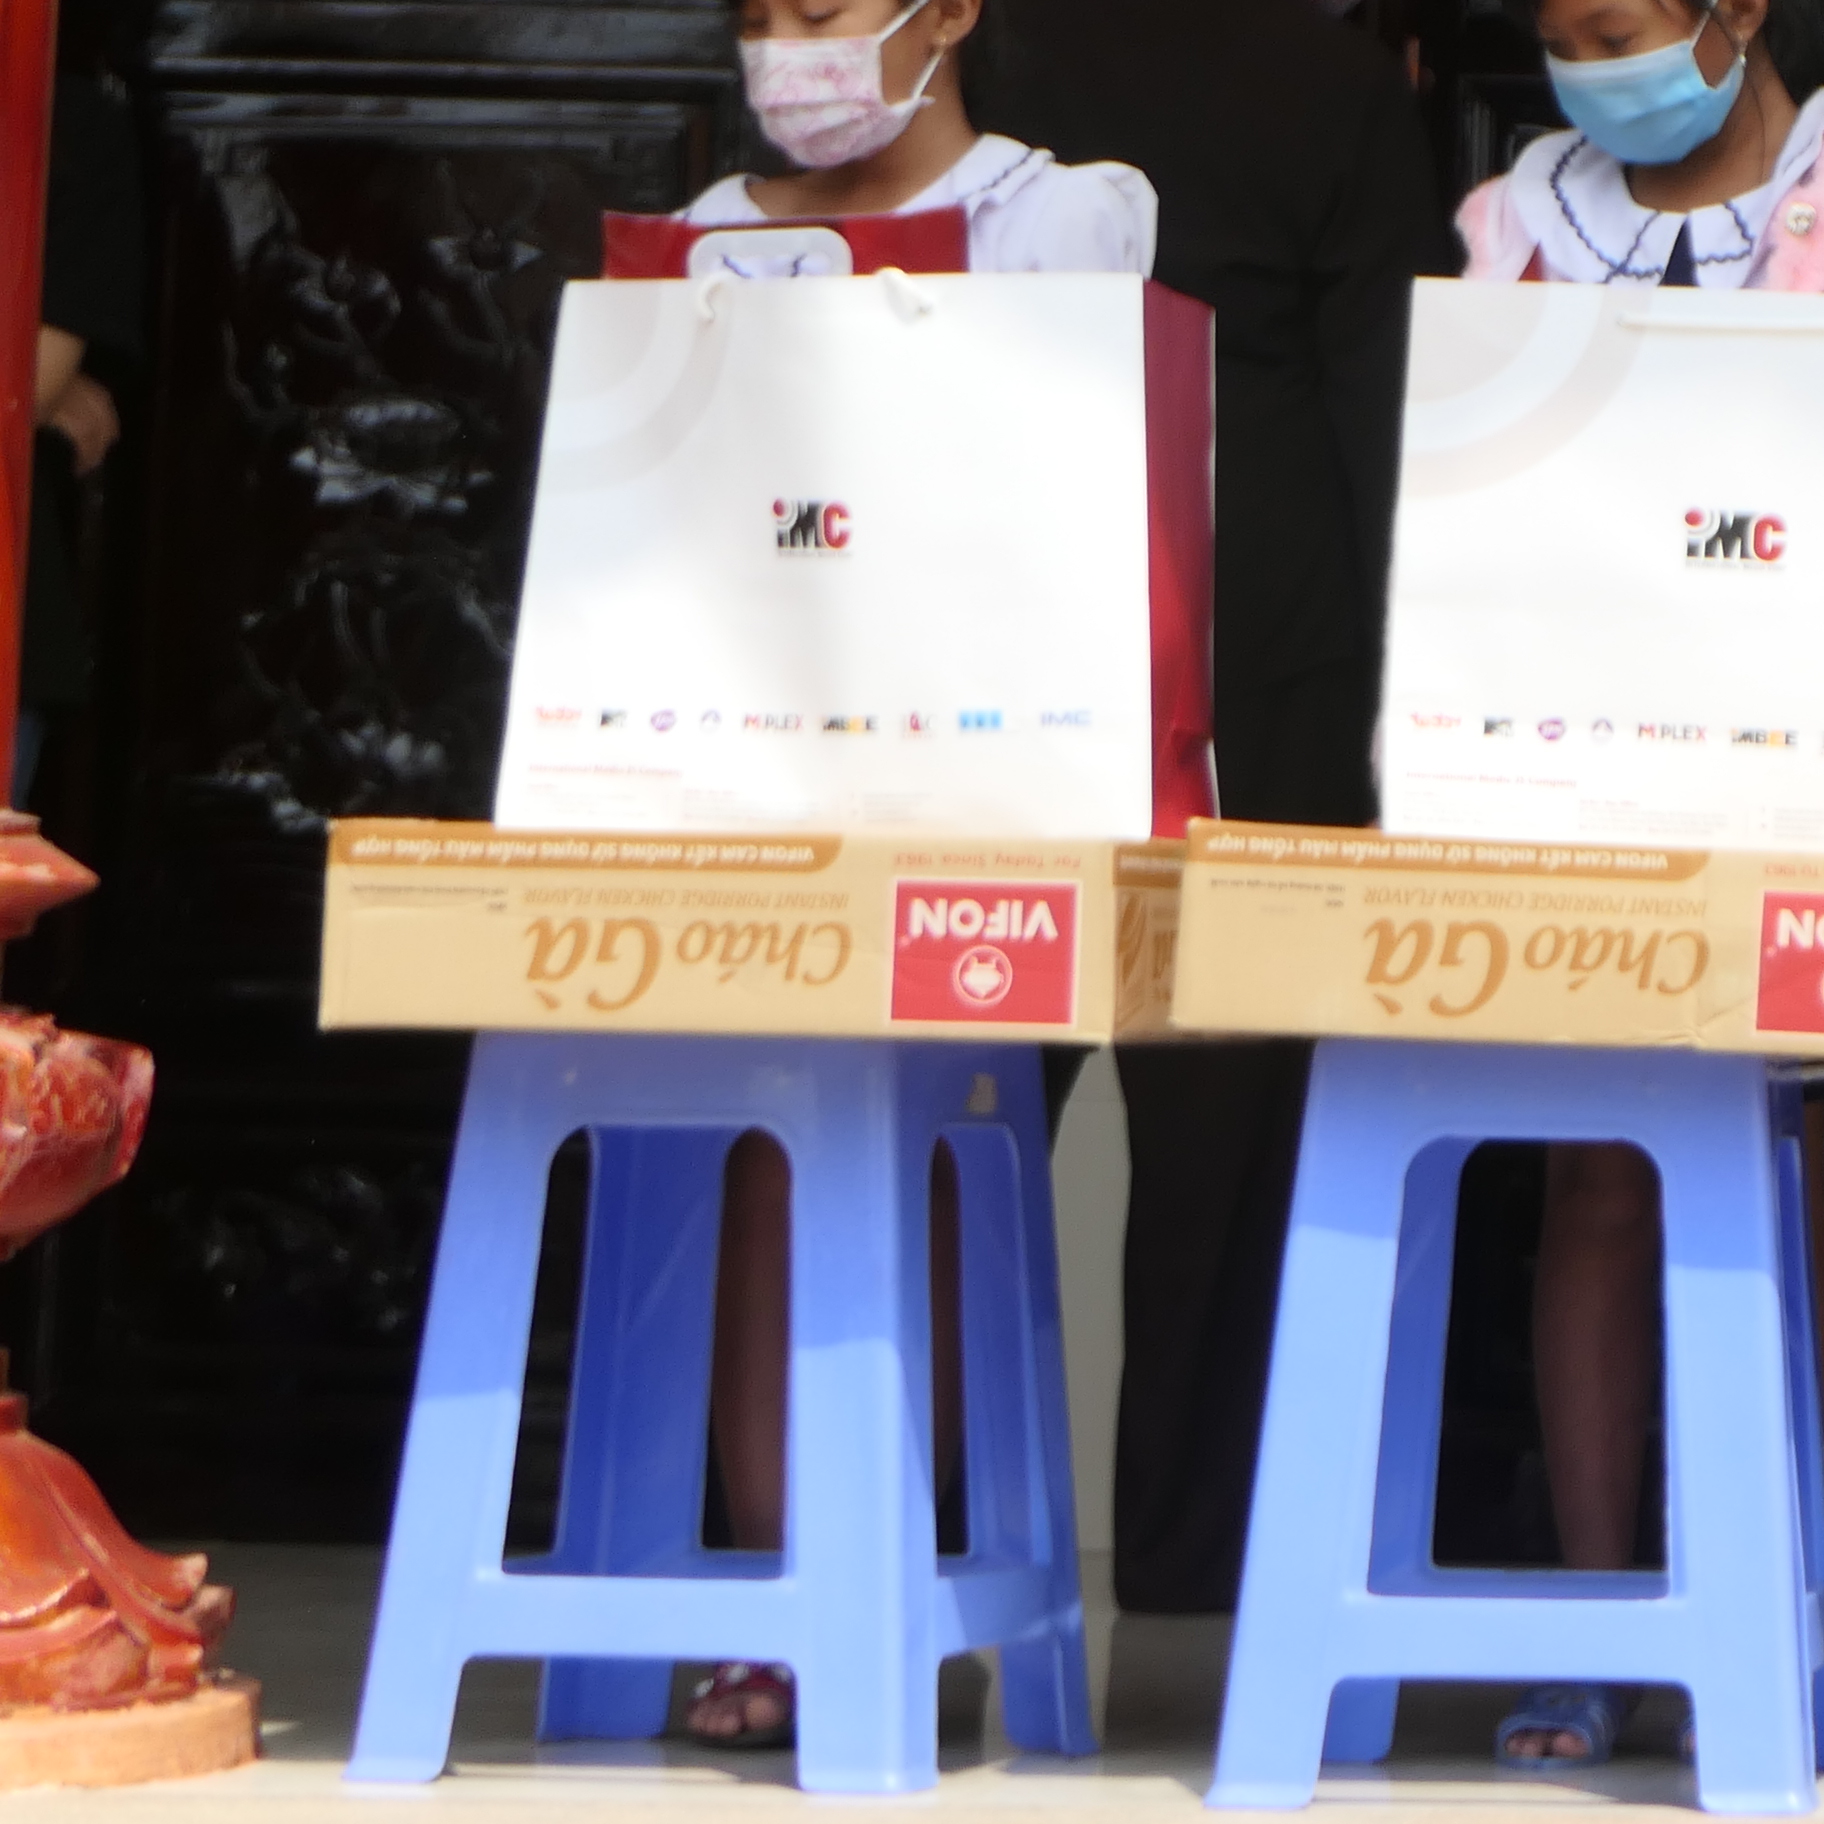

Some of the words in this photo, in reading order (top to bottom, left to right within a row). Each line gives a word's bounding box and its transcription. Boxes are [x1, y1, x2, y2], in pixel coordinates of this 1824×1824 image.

[675, 921, 850, 986] Cháo
[908, 897, 1059, 942] VIFON
[524, 917, 661, 1012] Gà
[1362, 917, 1509, 1018] Gà
[1523, 926, 1711, 996] Cháo
